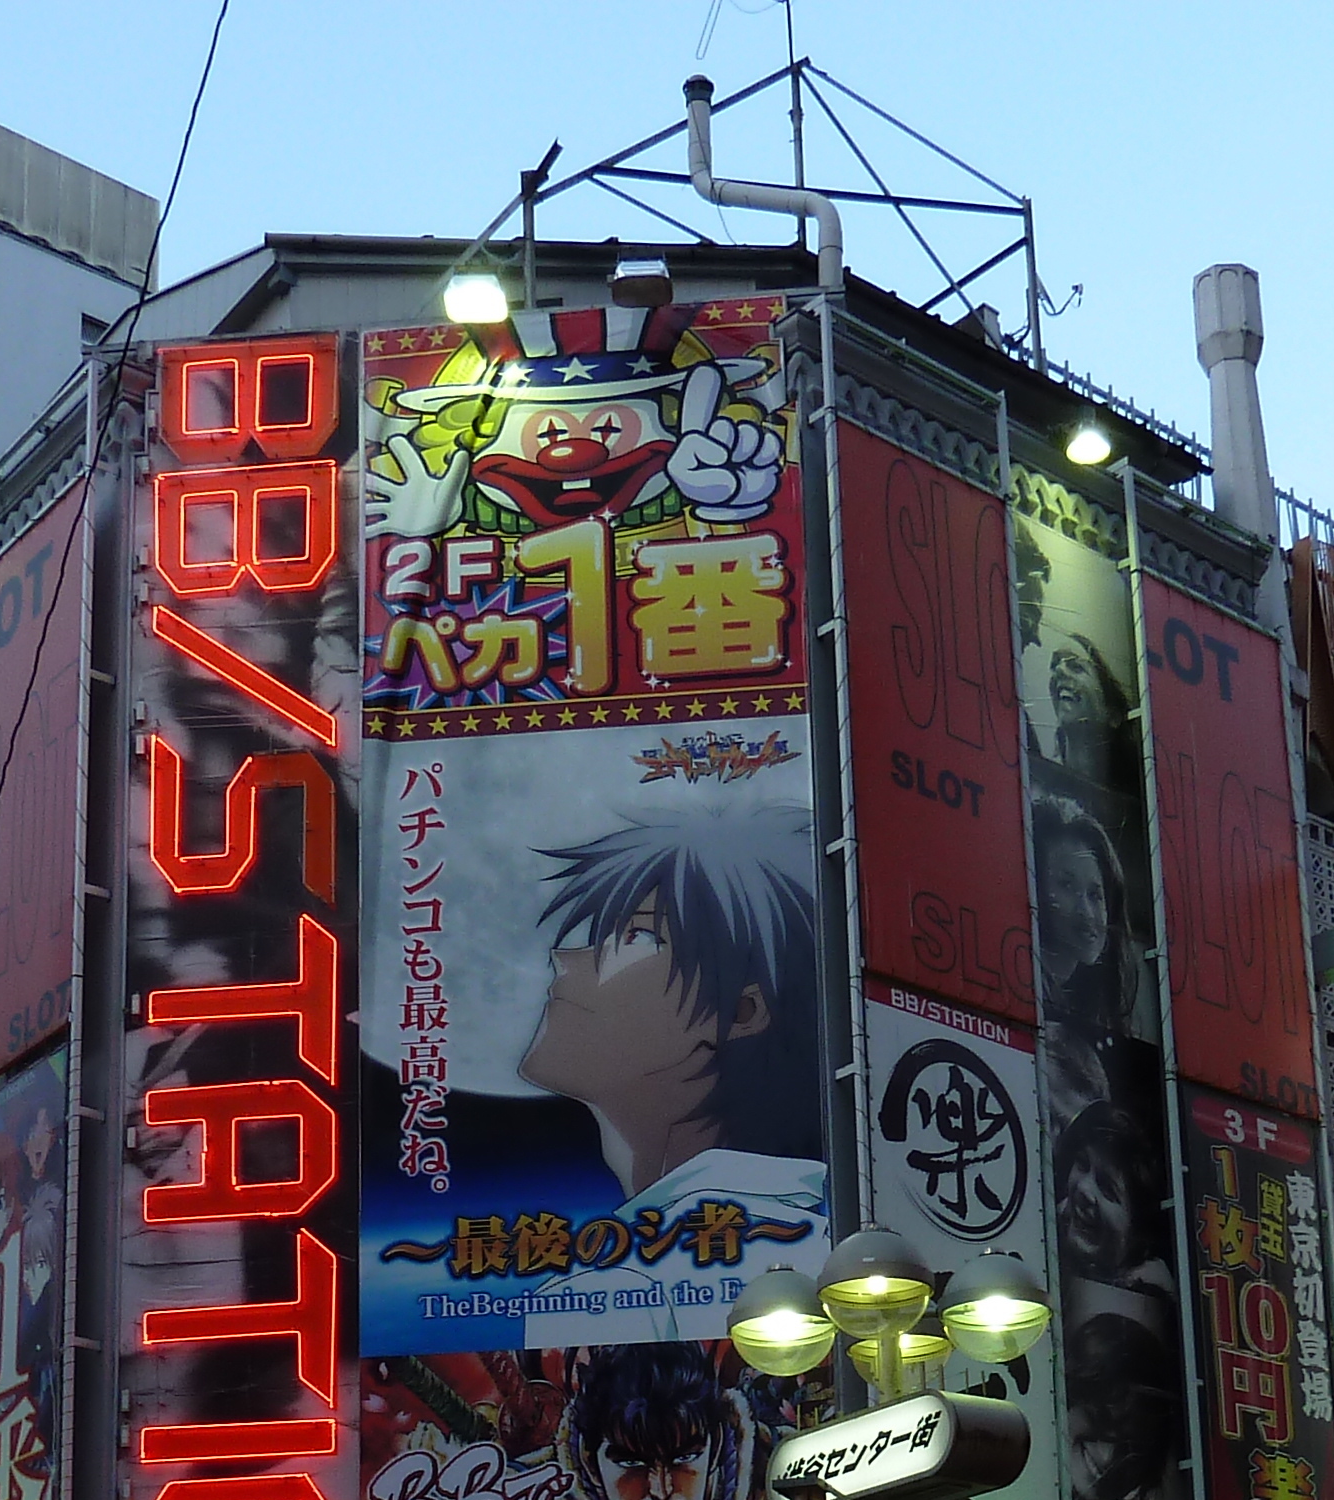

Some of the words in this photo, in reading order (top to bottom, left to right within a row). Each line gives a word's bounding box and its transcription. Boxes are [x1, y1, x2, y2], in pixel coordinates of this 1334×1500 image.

[386, 538, 498, 598] 2F
[384, 611, 546, 691] ペカ
[514, 516, 792, 696] 1番
[891, 749, 985, 818] SLOT
[398, 762, 451, 1194] パチンコも最高だね。
[890, 986, 1010, 1046] BB/STATION
[1223, 1108, 1278, 1151] 3F
[615, 1285, 666, 1309] and
[672, 1281, 714, 1306] the
